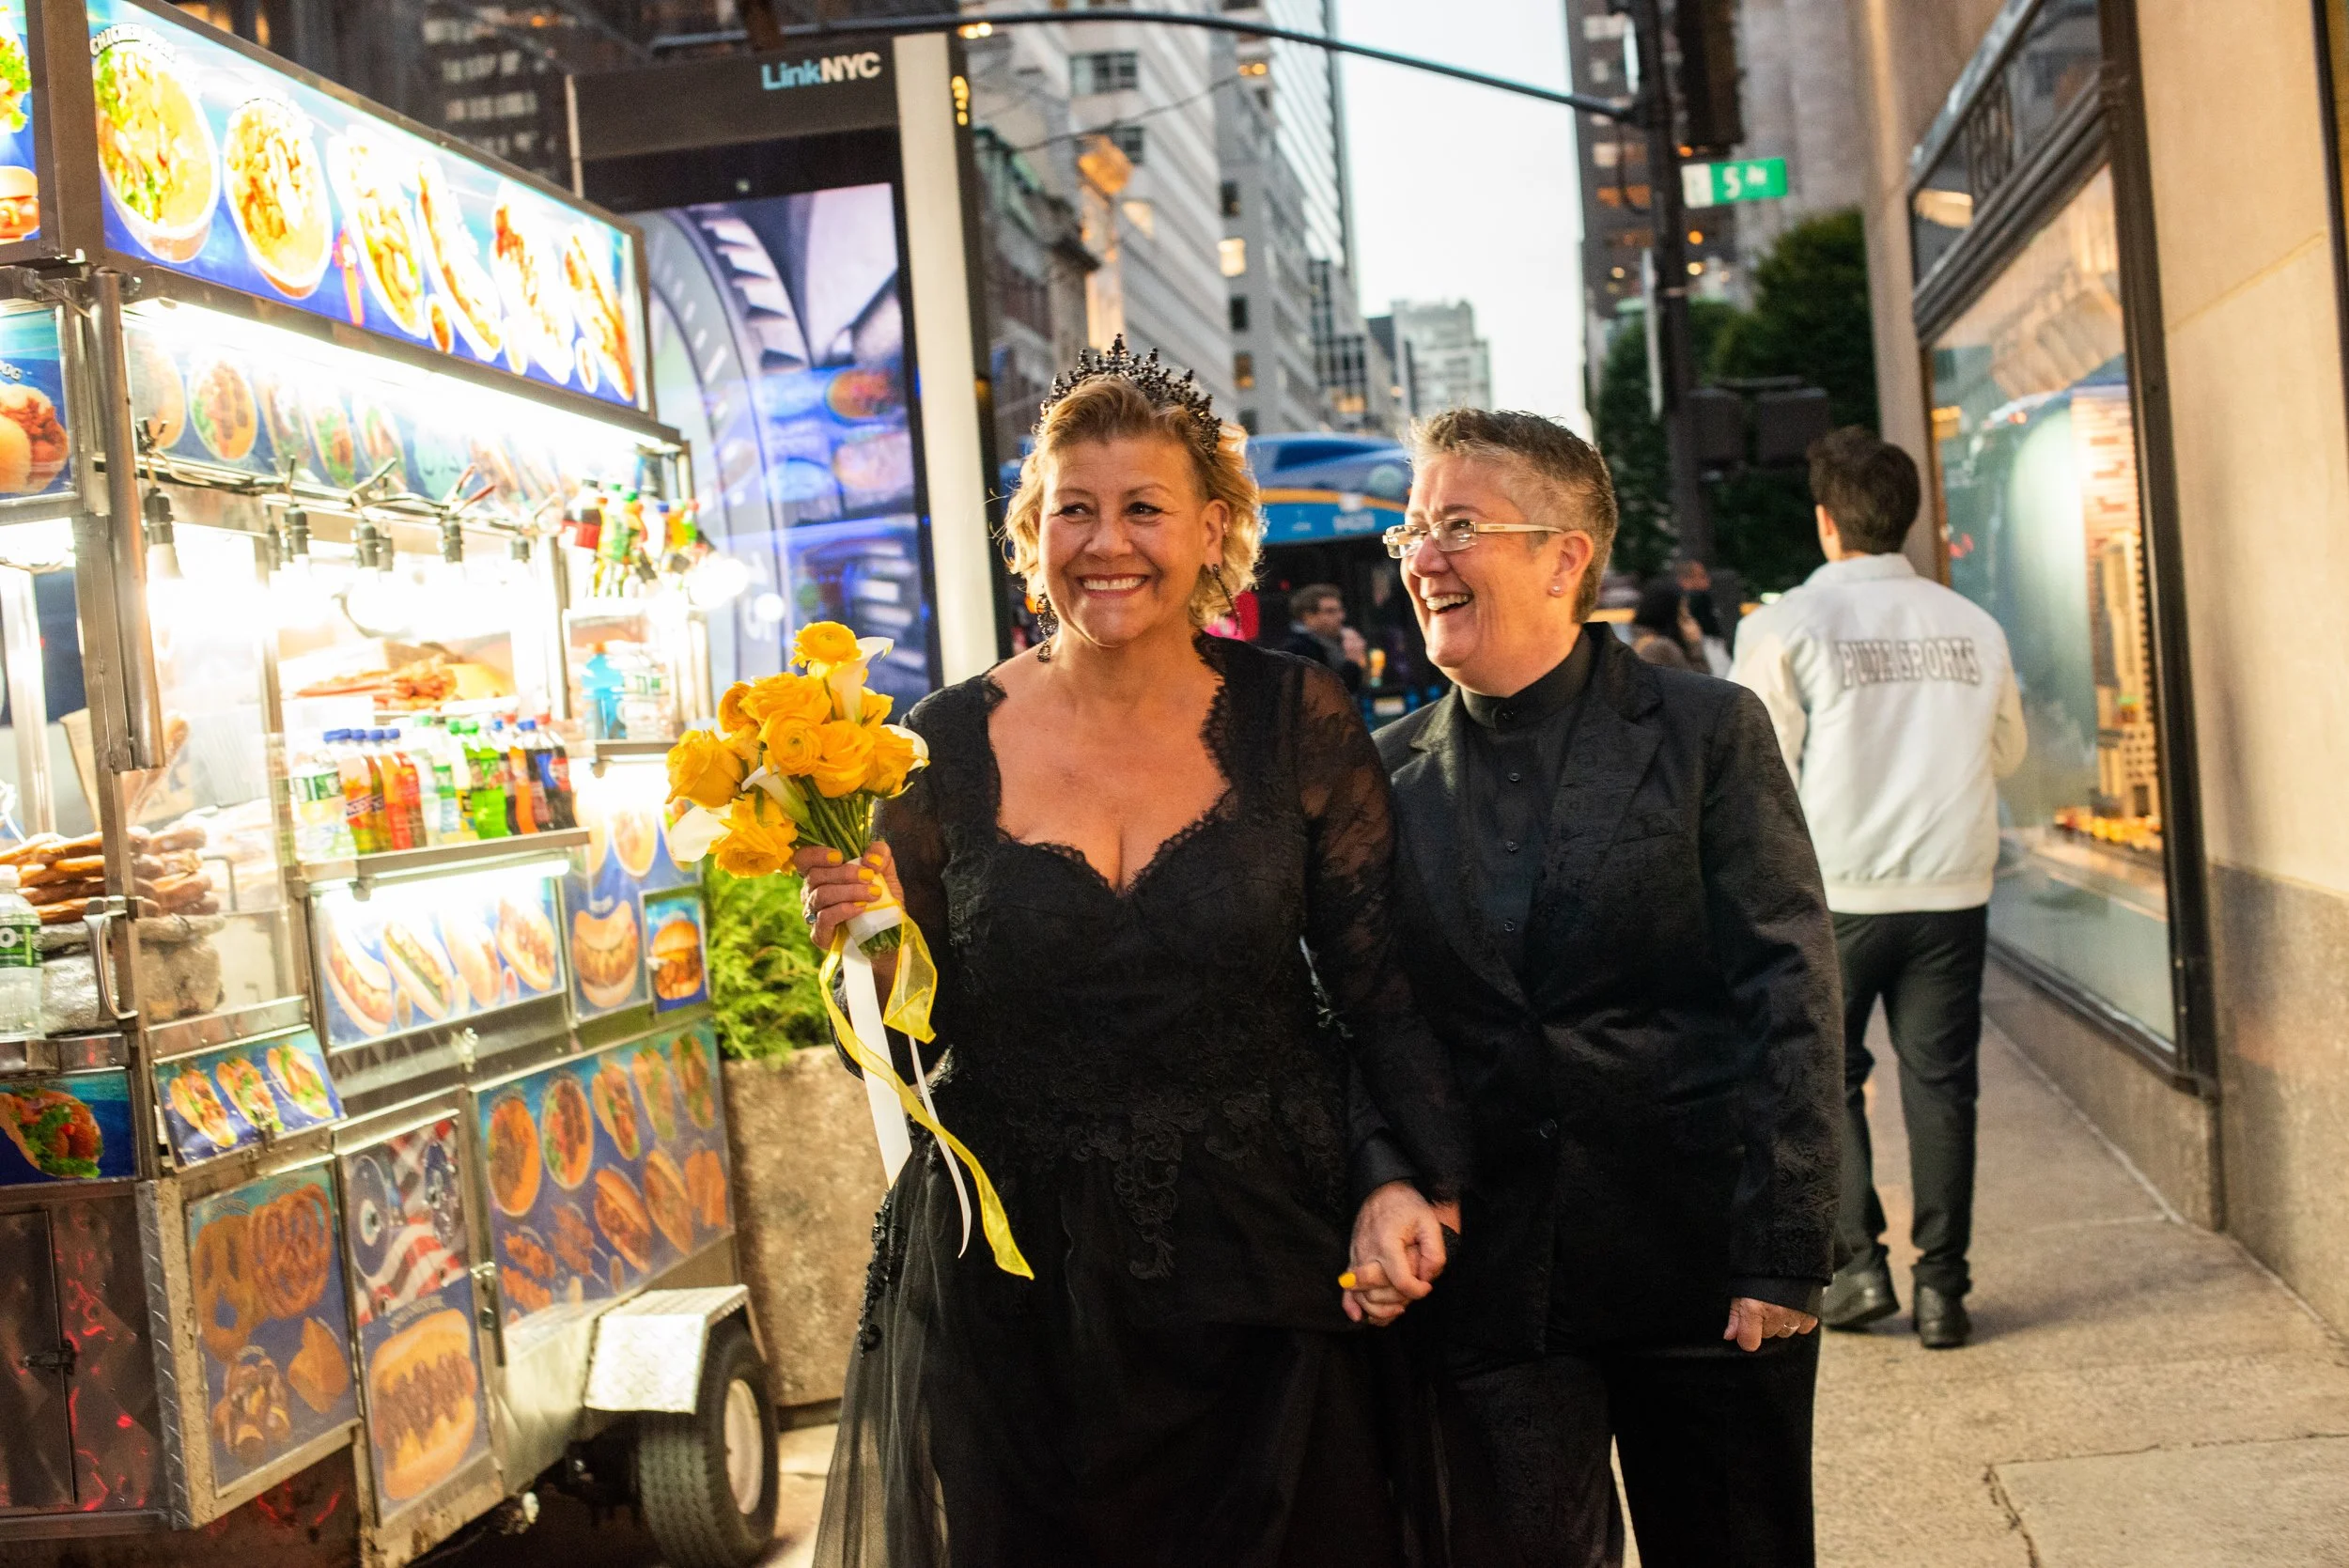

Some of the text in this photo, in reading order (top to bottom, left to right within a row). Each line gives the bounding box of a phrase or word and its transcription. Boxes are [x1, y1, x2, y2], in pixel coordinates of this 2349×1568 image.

[762, 51, 881, 90] LinkNYC
[1723, 165, 1741, 199] 5
[1896, 637, 1982, 687] SPORTS
